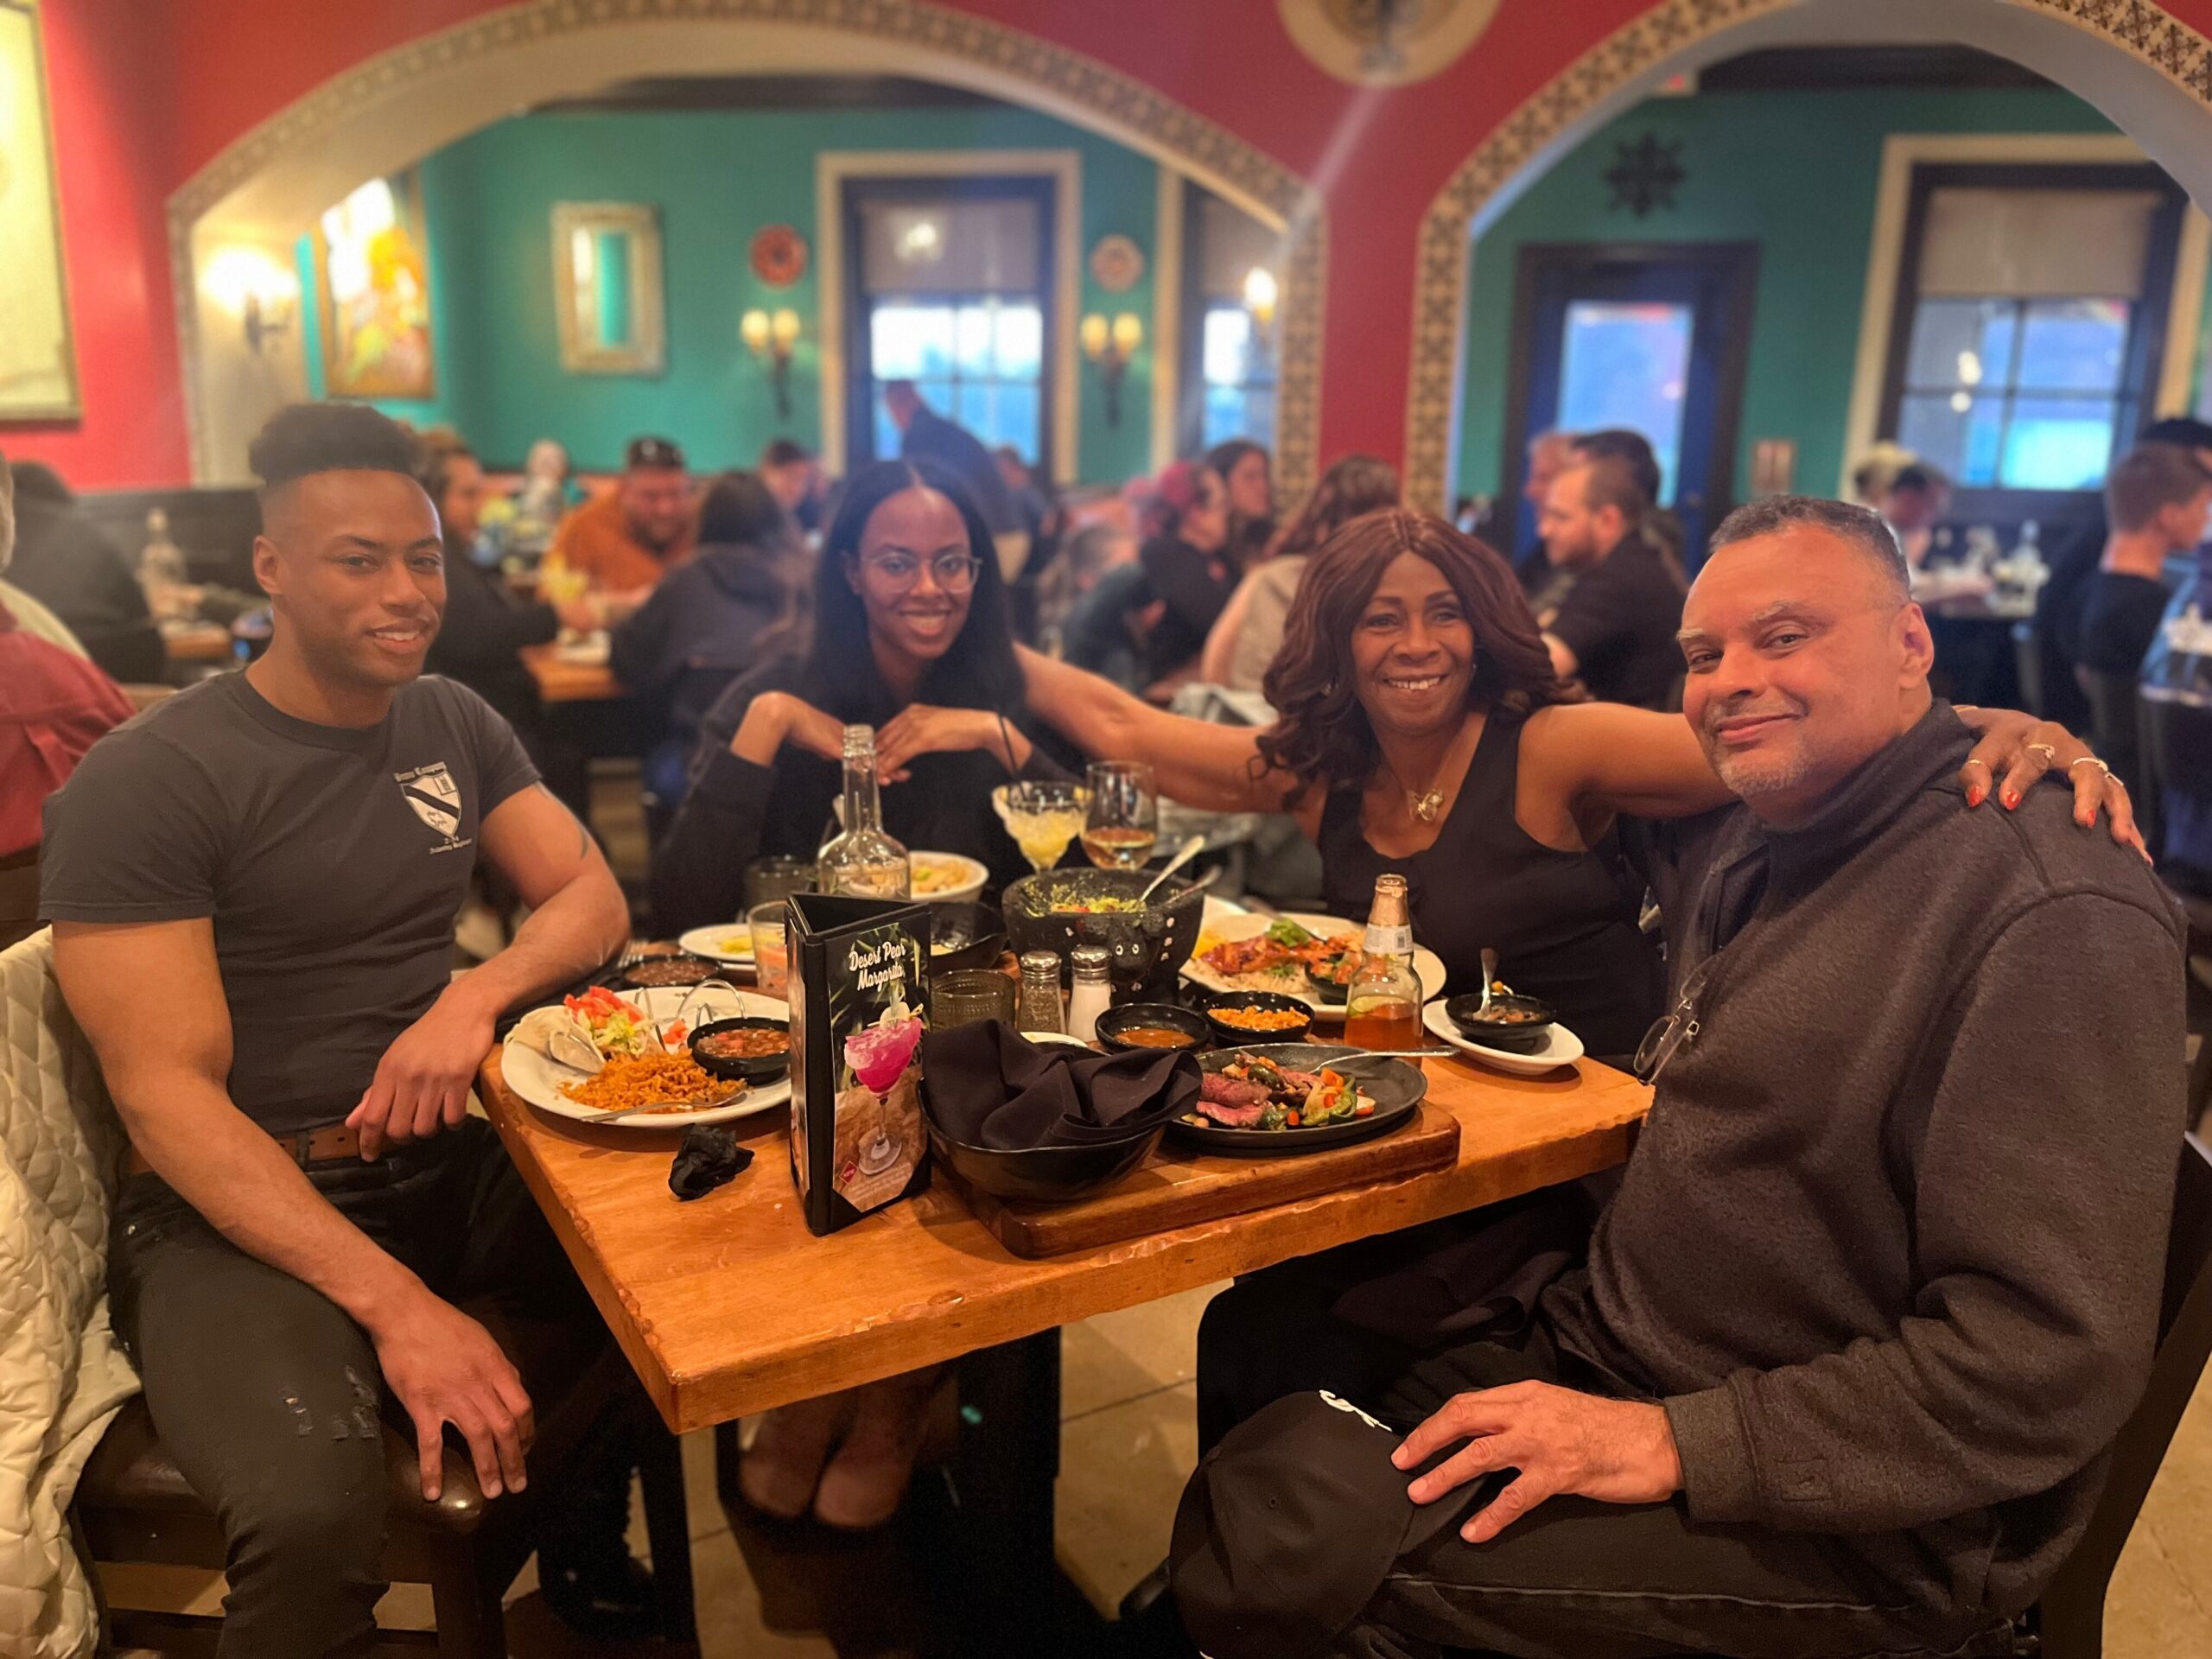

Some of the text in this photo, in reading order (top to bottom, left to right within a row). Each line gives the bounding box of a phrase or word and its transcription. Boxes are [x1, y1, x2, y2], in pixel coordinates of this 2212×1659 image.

[849, 941, 906, 971] Desert Pear
[857, 961, 906, 992] Margarita
